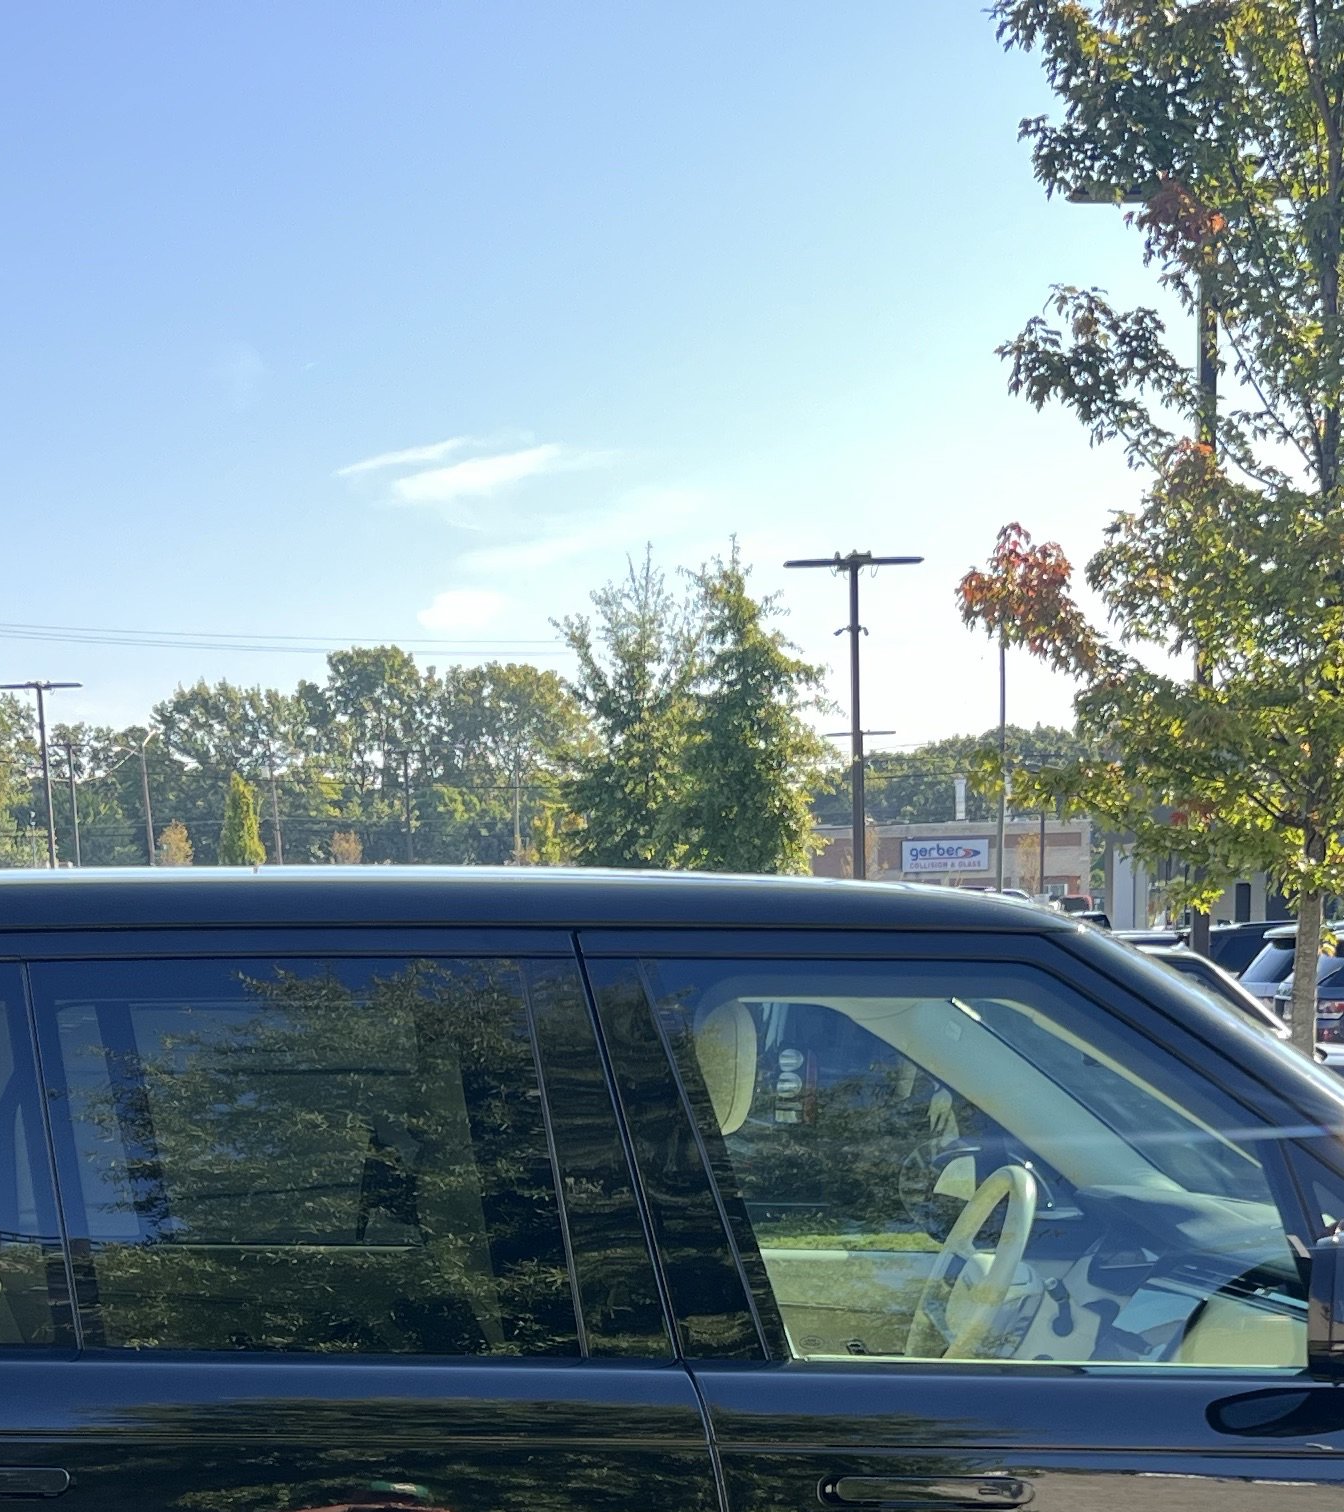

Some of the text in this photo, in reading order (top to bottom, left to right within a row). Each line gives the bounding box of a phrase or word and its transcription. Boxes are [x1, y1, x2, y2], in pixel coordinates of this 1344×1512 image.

[909, 843, 963, 861] gerber
[909, 862, 948, 870] COLLISION
[958, 860, 981, 868] GLASS
